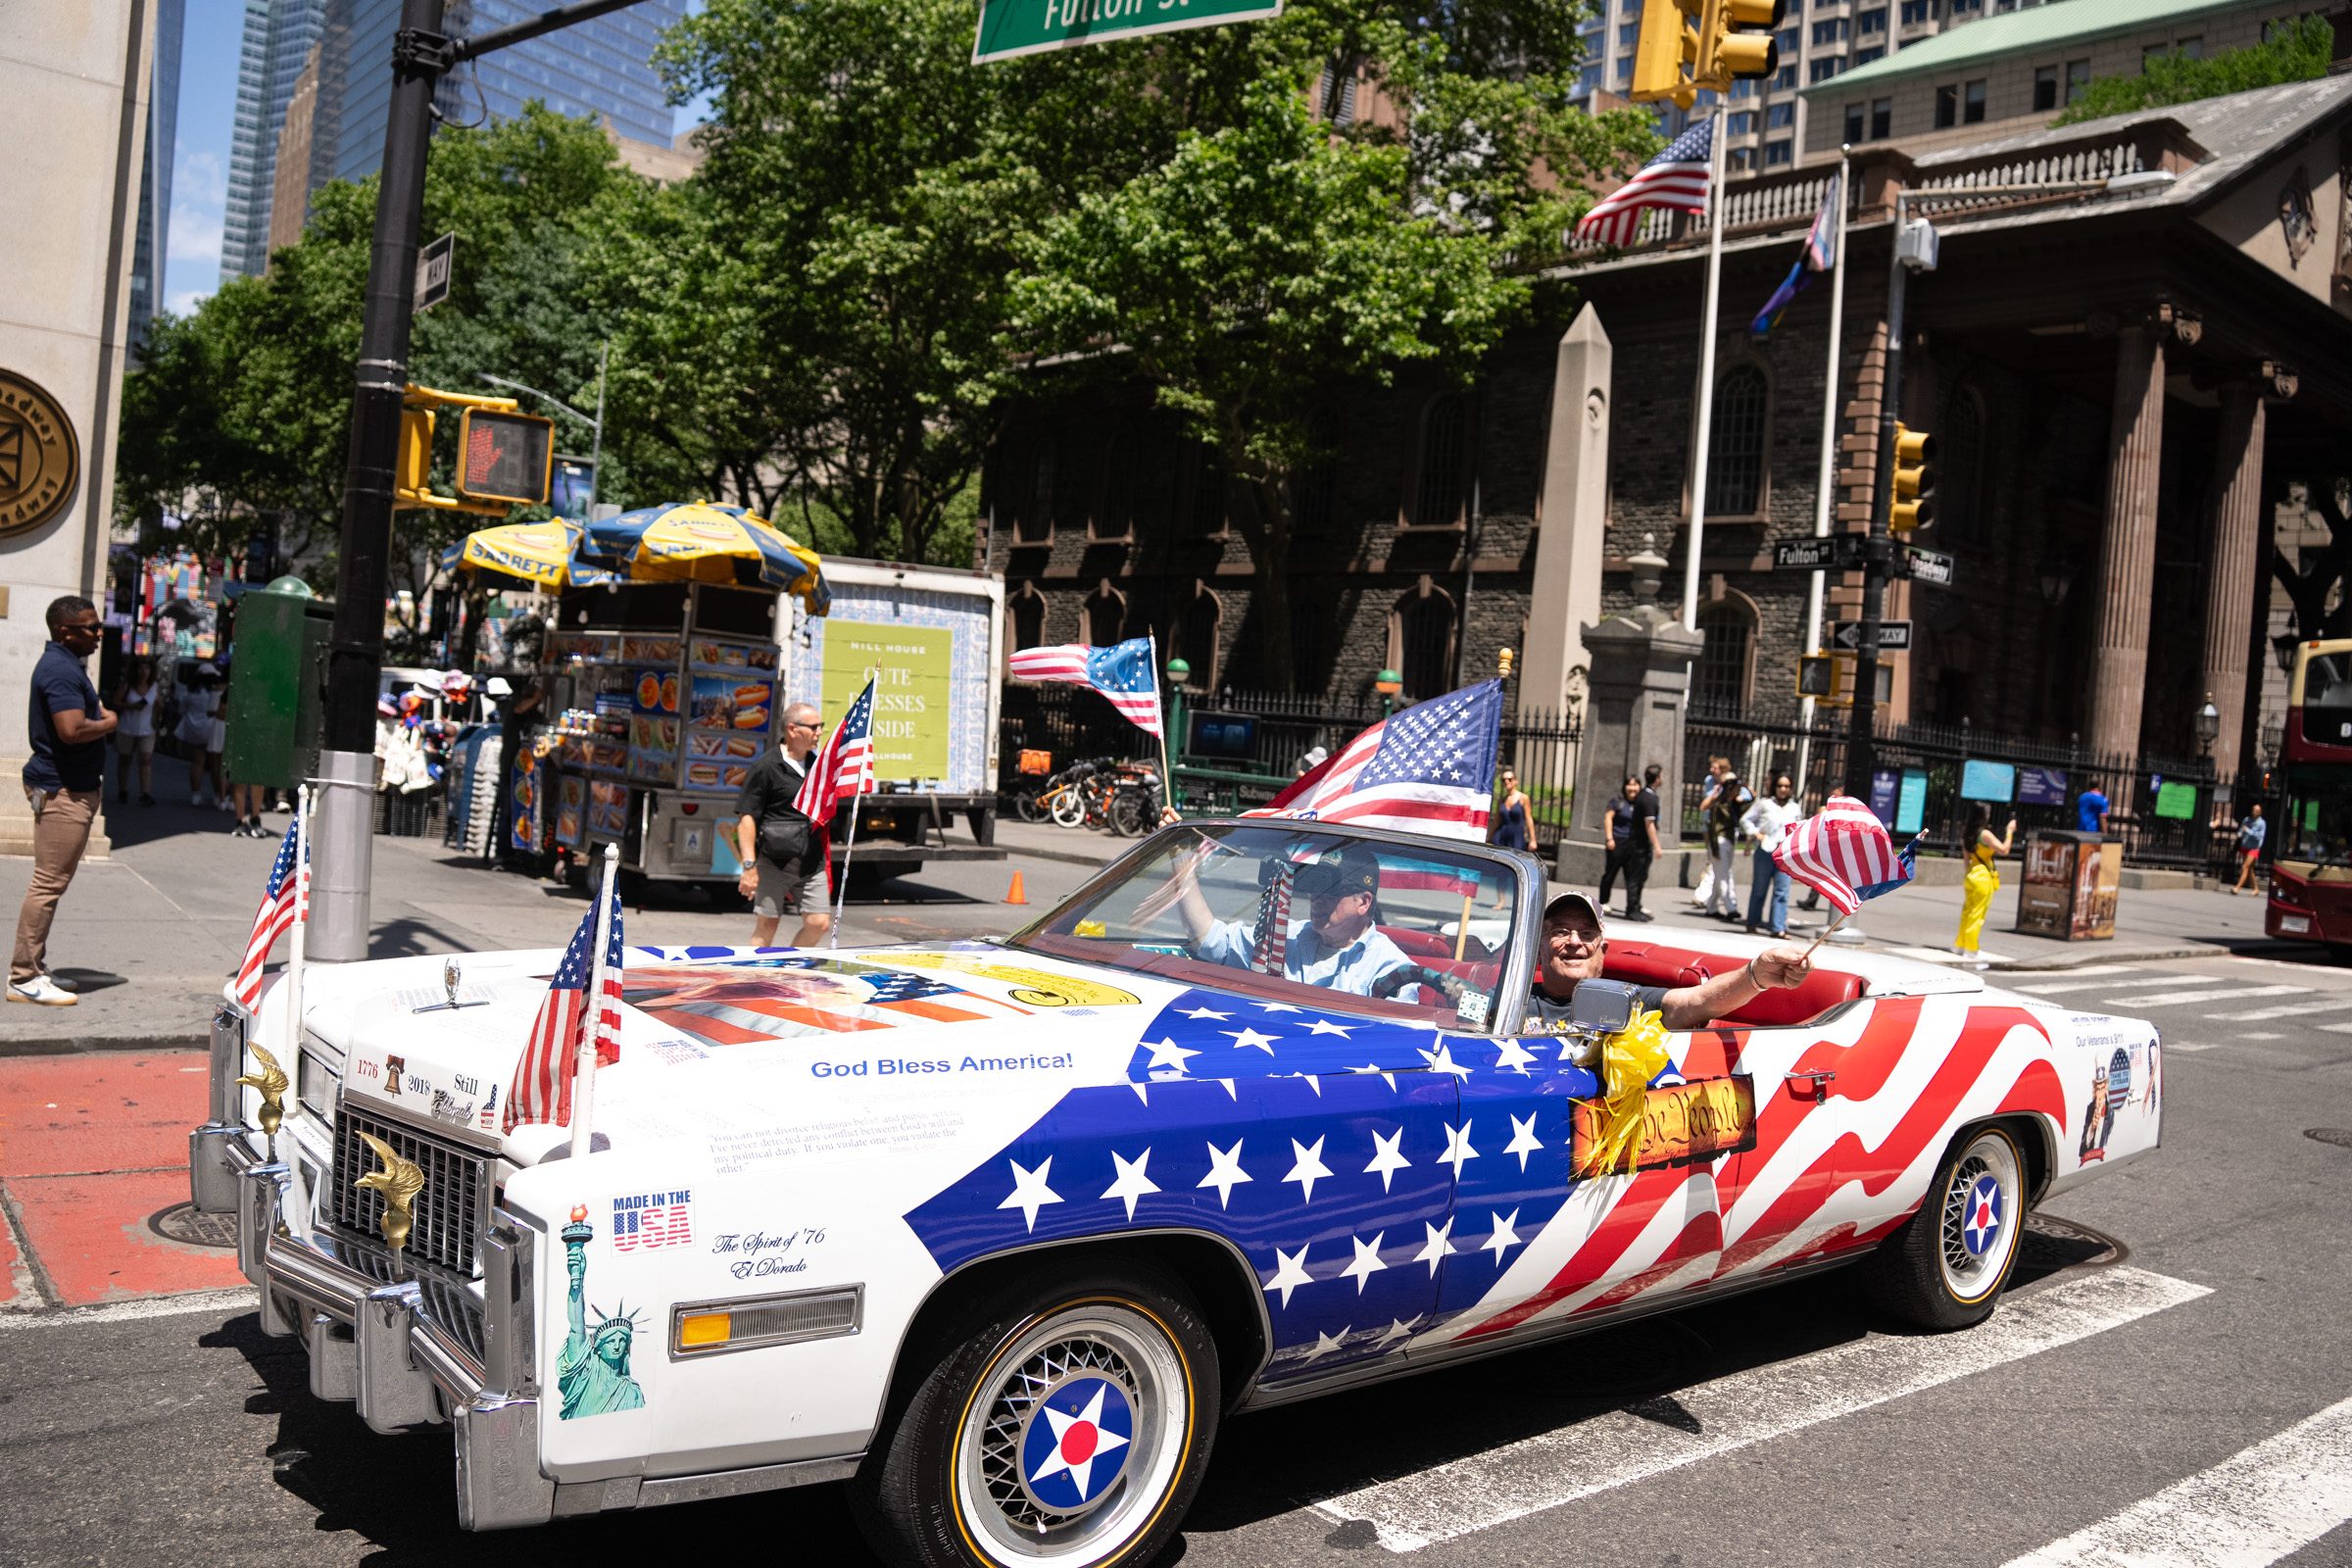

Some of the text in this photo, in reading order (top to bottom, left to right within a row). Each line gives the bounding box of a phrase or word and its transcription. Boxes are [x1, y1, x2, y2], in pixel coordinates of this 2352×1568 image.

[1779, 547, 1819, 564] Fulton
[1910, 555, 1949, 582] Broadway
[886, 645, 926, 655] HOUSE
[863, 665, 912, 686] CUTE
[849, 692, 925, 713] DESSES
[875, 720, 915, 739] SIDE
[2076, 1036, 2085, 1047] Our
[2087, 1036, 2110, 1047] Veterans
[358, 1059, 378, 1079] 1776
[811, 1053, 1074, 1078] God Bless America!
[408, 1075, 430, 1096] 2018
[454, 1073, 478, 1096] Still
[756, 1129, 771, 1138] not
[774, 1126, 809, 1136] divorce
[811, 1121, 853, 1132] religious
[883, 1114, 900, 1123] and
[902, 1111, 929, 1124] public
[1668, 1086, 1741, 1146] People
[731, 1141, 758, 1151] never
[760, 1135, 801, 1148] detected
[804, 1133, 821, 1144] any
[823, 1128, 859, 1140] conflict
[861, 1125, 899, 1136] between
[900, 1121, 927, 1132] God's
[929, 1118, 946, 1128] will
[948, 1116, 964, 1126] and
[713, 1155, 729, 1164] my
[732, 1149, 773, 1164] political
[816, 1143, 834, 1153] you
[836, 1138, 867, 1150] violate
[892, 1135, 909, 1145] you
[910, 1129, 941, 1141] violate
[943, 1127, 956, 1137] the
[613, 1190, 691, 1211] MADE IN THE
[613, 1205, 692, 1251] USA
[711, 1227, 827, 1255] The Spirit of '76
[730, 1257, 808, 1280] El Dorado
